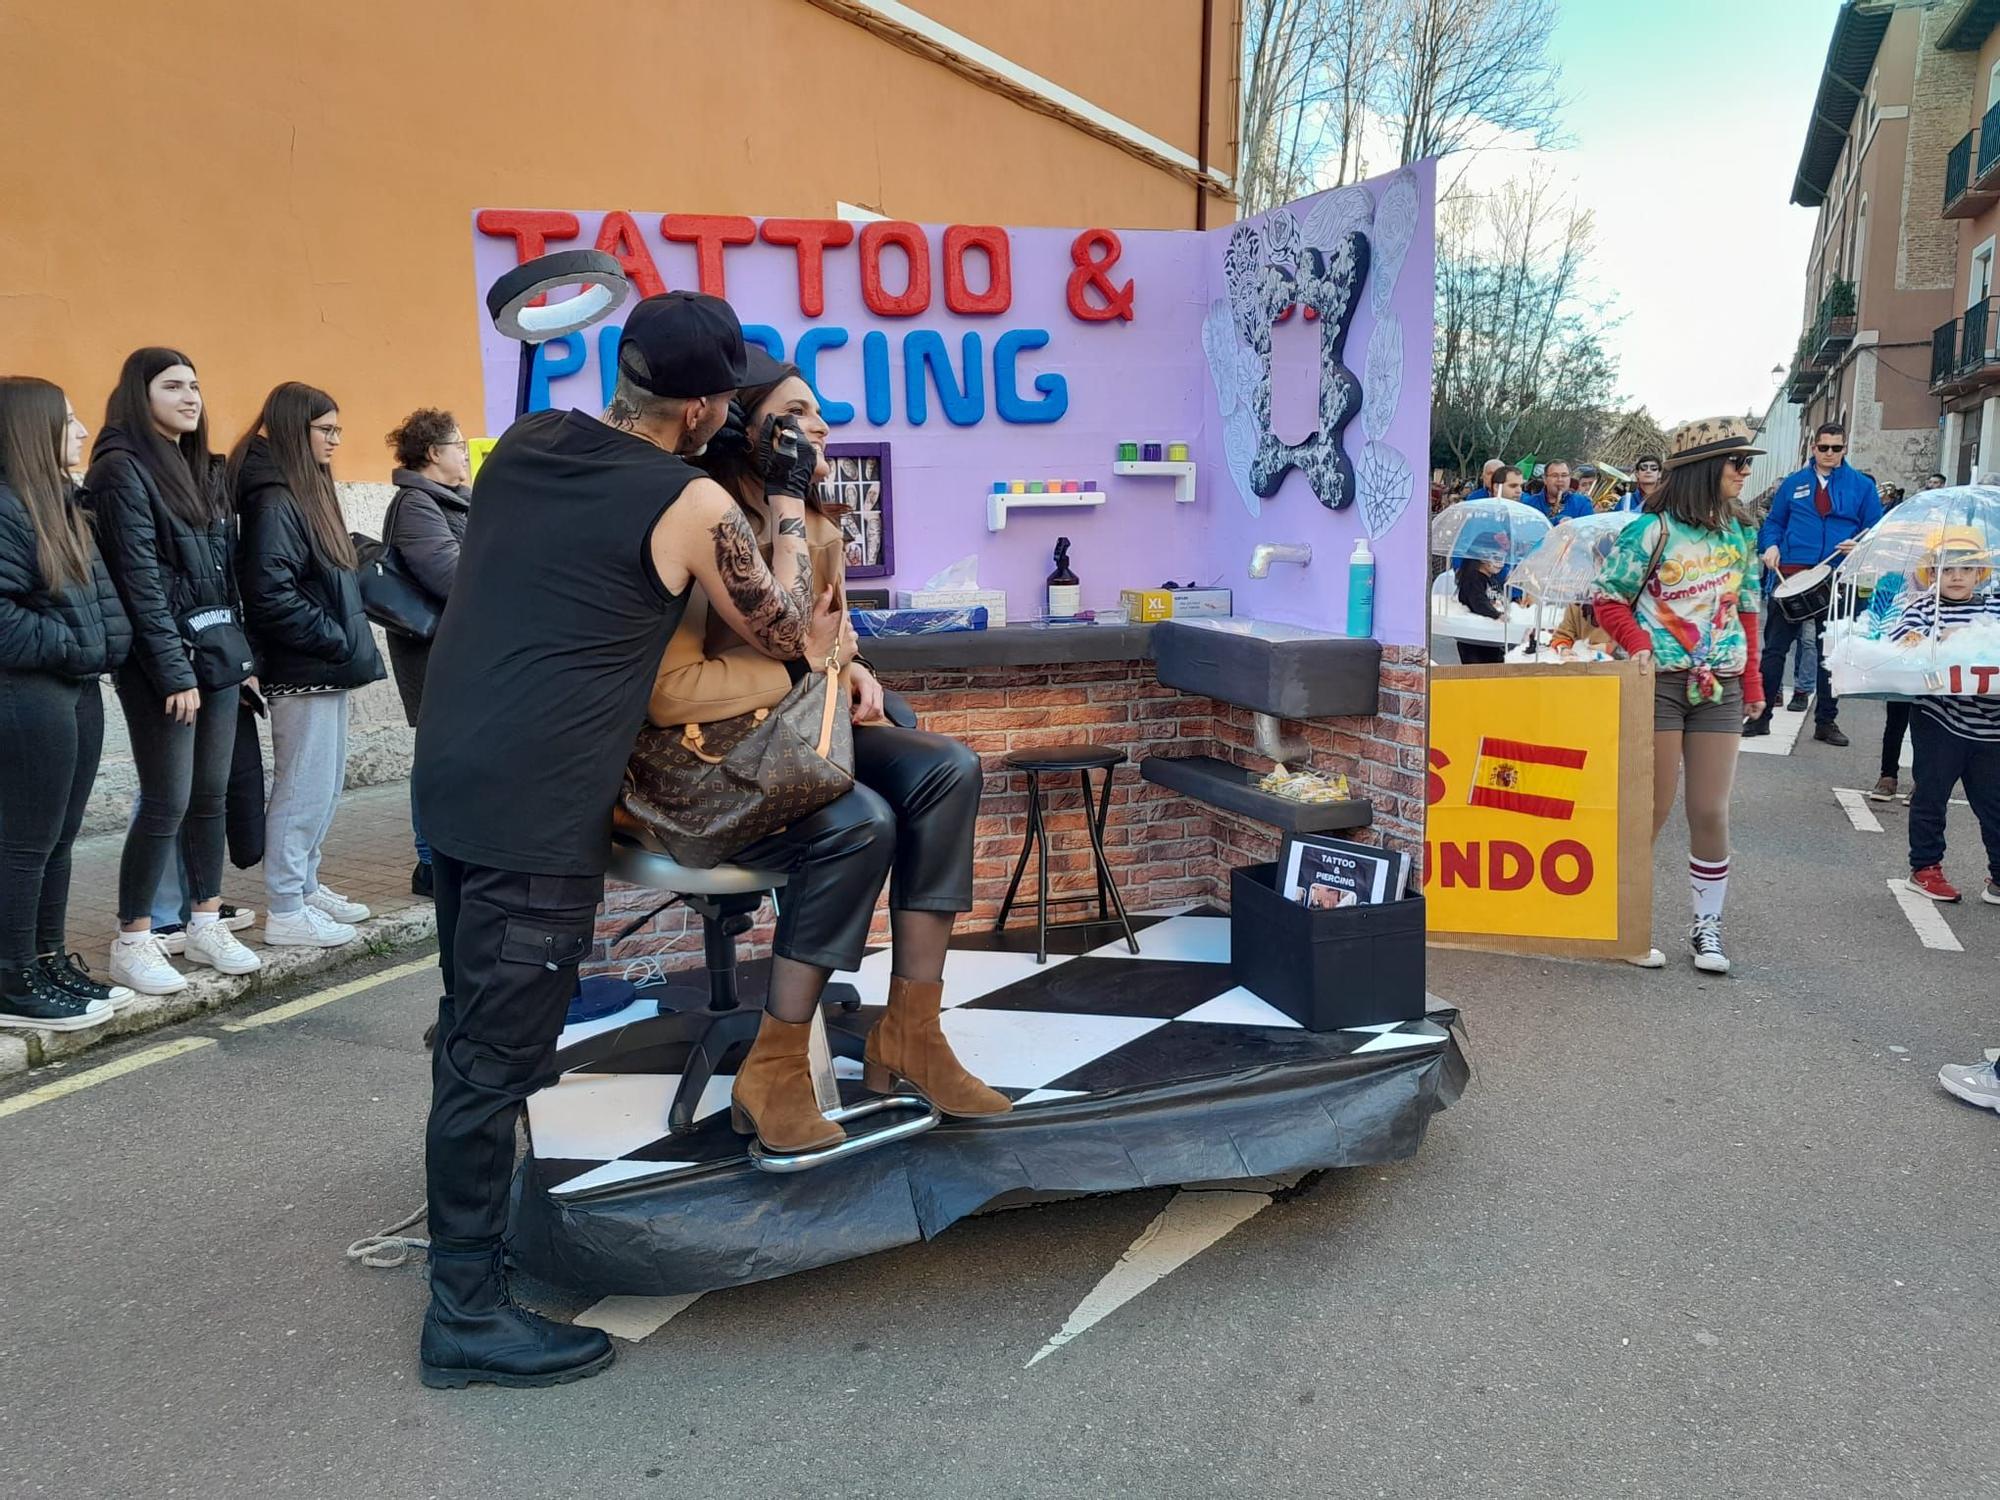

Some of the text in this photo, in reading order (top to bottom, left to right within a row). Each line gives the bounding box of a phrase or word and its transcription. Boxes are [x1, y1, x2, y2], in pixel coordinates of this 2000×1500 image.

[477, 209, 1135, 322] TATTOO &
[527, 324, 1068, 427] PICING
[1148, 597, 1166, 609] XL
[188, 609, 231, 632] HOODRICH
[1949, 665, 1999, 695] IT
[1321, 854, 1356, 869] TATTOO
[1333, 866, 1340, 874] &
[1424, 839, 1594, 896] NDO
[1316, 871, 1355, 887] PIERCING
